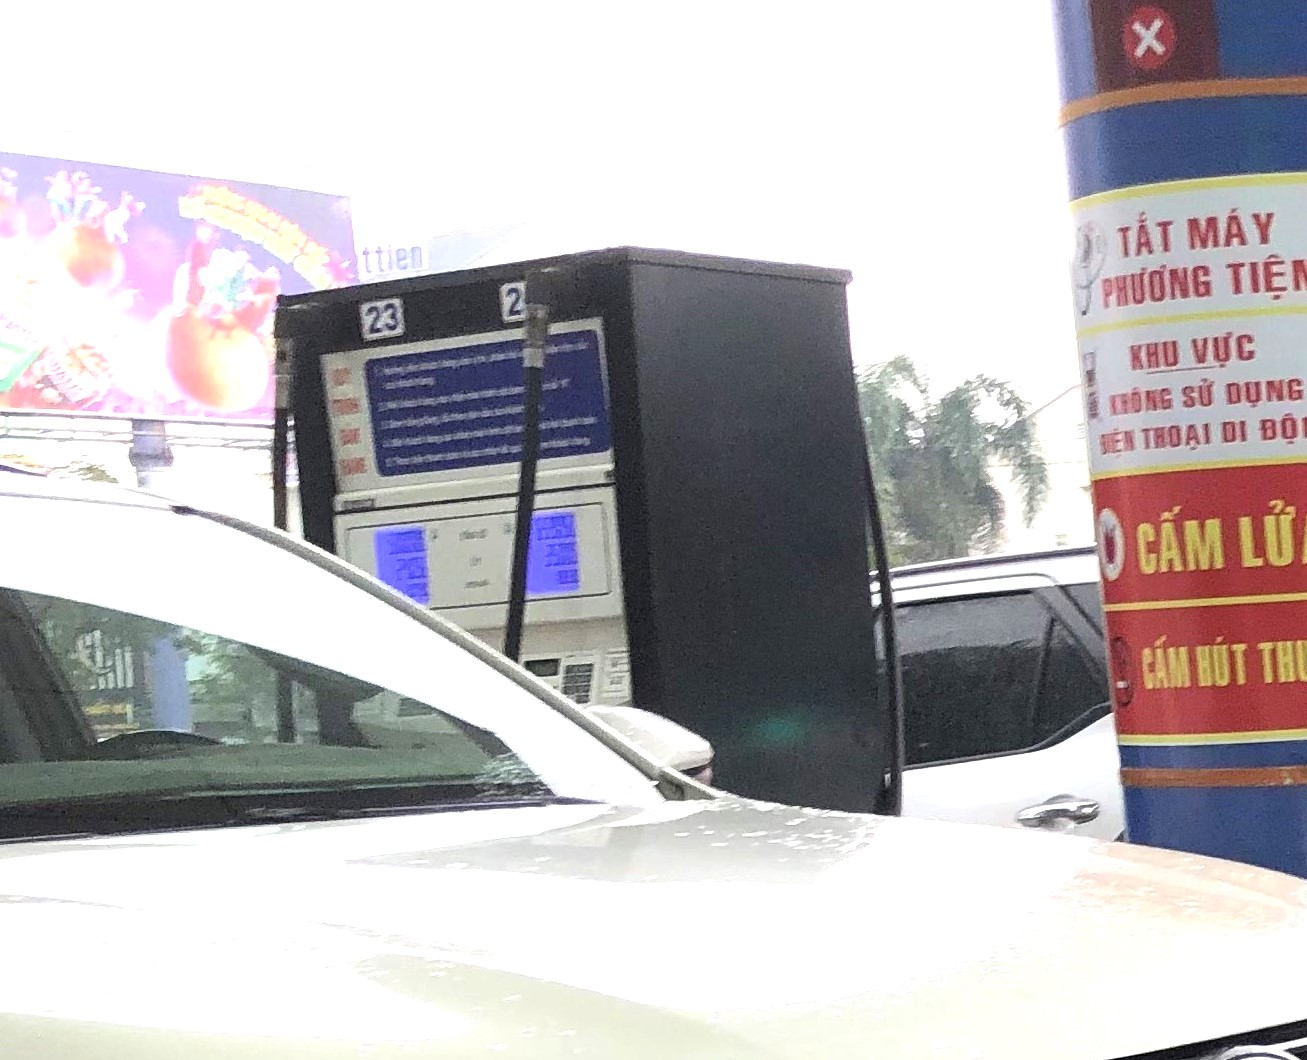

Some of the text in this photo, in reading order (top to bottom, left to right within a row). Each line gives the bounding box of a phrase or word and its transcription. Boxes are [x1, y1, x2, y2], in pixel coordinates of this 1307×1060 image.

[1117, 208, 1274, 258] TẮT MÁY
[363, 245, 423, 272] ttien
[505, 287, 523, 316] 2
[1102, 264, 1212, 309] PHƯƠNG
[366, 302, 399, 334] 23
[1129, 332, 1256, 371] KHU VỰC
[1109, 378, 1304, 416] KHÔNG SỬ DỤNG
[1142, 422, 1211, 451] THOẠI
[1220, 420, 1247, 443] DI
[1136, 505, 1223, 575] CẤM
[1141, 635, 1192, 690] CẤM
[1196, 635, 1247, 687] HÚT
